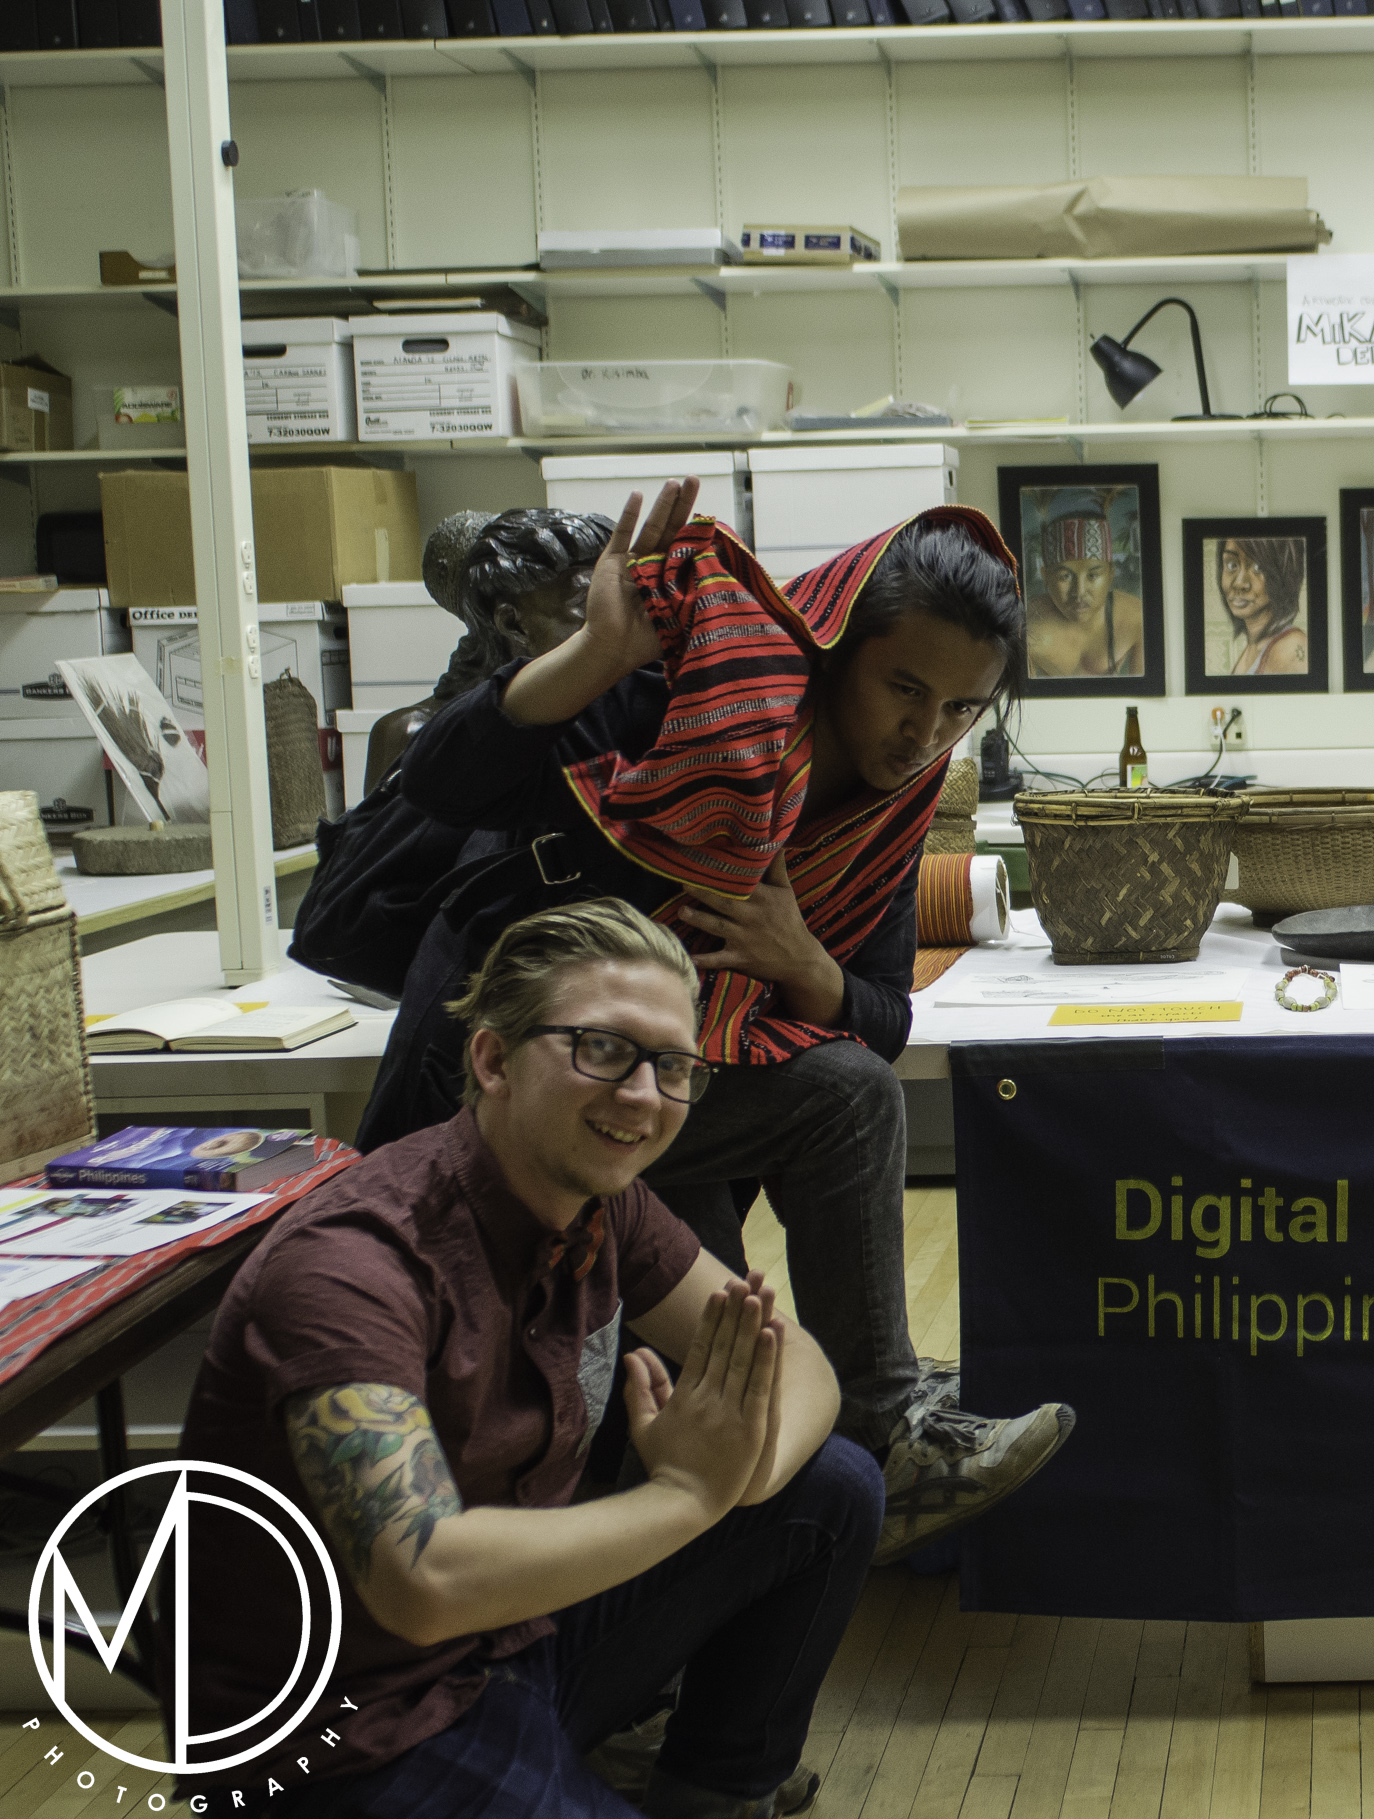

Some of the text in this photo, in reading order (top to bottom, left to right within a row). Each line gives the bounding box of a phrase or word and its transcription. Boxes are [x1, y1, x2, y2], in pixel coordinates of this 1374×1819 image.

[132, 610, 175, 621] Office
[78, 1167, 147, 1185] Philippines
[1115, 1176, 1349, 1259] Digital
